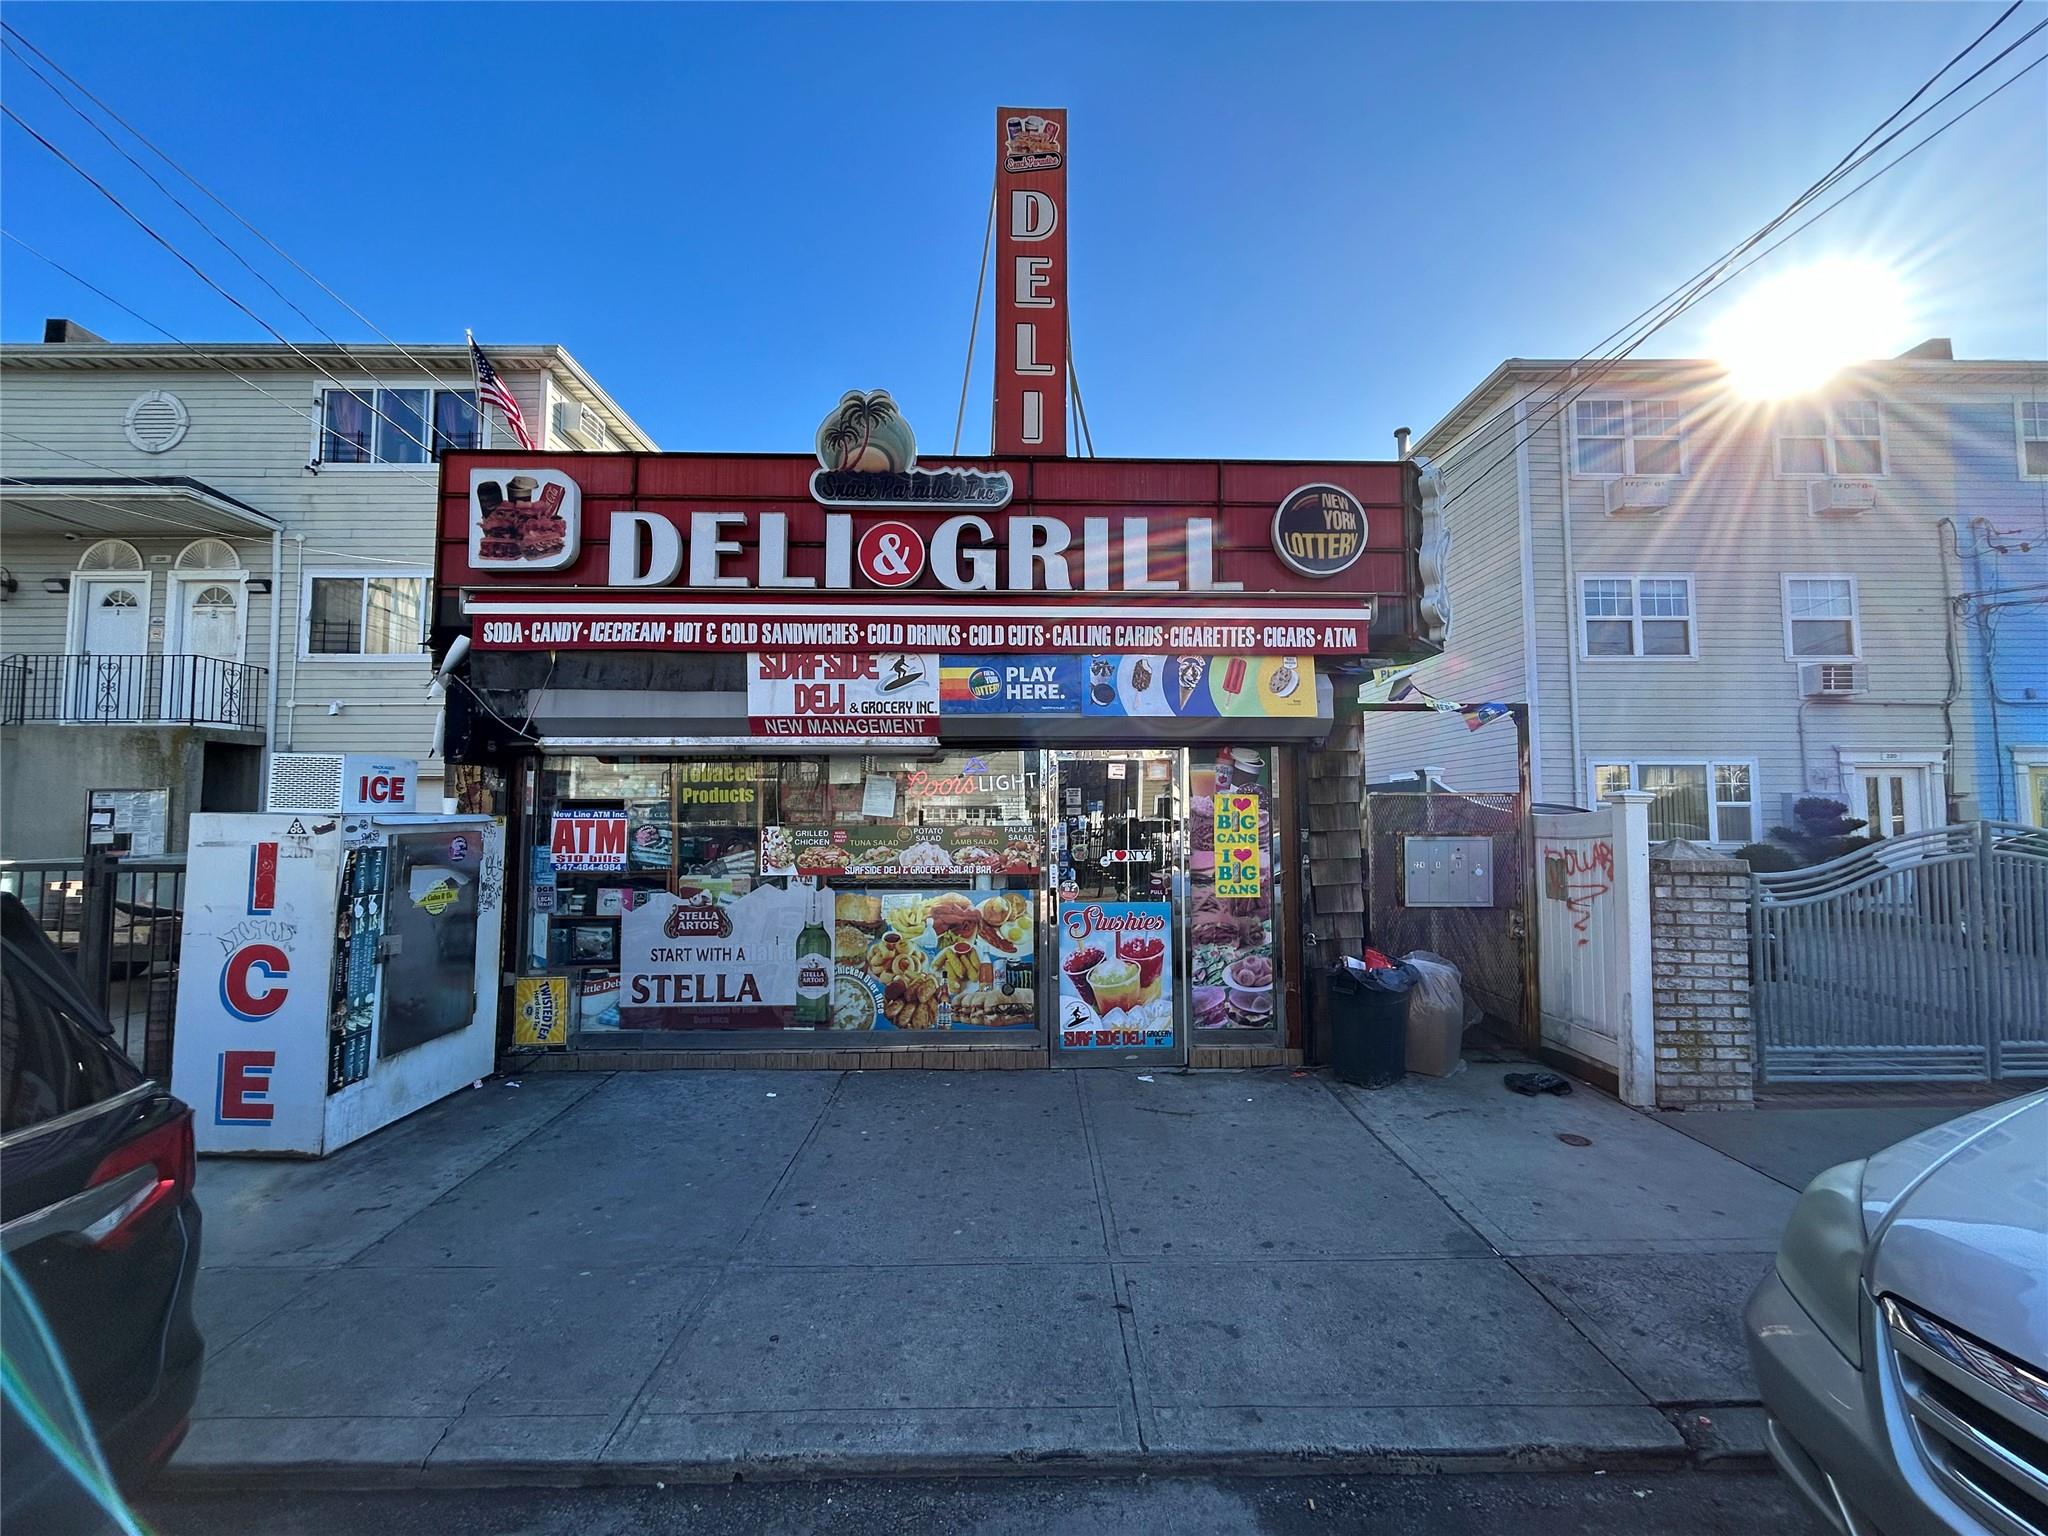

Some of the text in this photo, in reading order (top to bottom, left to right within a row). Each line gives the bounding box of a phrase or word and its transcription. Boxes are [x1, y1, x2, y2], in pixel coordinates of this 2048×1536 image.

[1010, 190, 1058, 445] DELI
[822, 474, 1000, 501] Snack Paradise Inc.
[1321, 493, 1349, 510] NEW
[1323, 510, 1357, 530] YORK
[608, 511, 1244, 591] DELI & GRILL
[1284, 531, 1359, 560] LOTTERY
[483, 621, 1357, 648] SODA CANDY ICECREAM HOT & COLD SANDWICHES COLD DRINKS COLD CUTS CALLING CARDS CIGARETTES CIGARS ATM
[1006, 666, 1057, 682] PLAY
[794, 683, 938, 715] DELI & GROCERY INC.
[1006, 683, 1066, 700] HERE.
[764, 718, 926, 735] NEW MANAGEMENT
[359, 775, 406, 804] ICE
[907, 769, 978, 798] Coors
[978, 772, 1037, 792] LIGHT
[682, 787, 755, 804] Products
[1222, 797, 1230, 812] I
[553, 810, 572, 818] New
[573, 810, 591, 818] Line
[551, 820, 625, 853] ATM
[913, 827, 944, 835] POTATO
[1216, 832, 1257, 844] CANS
[794, 838, 830, 846] CHICKEN
[850, 839, 872, 847] TUNA
[973, 838, 999, 846] SALAD
[556, 854, 621, 863] $10 bills
[1109, 850, 1114, 861] I
[1222, 849, 1231, 863] I
[555, 863, 622, 871] 347-484-4984
[844, 865, 881, 875] SURFSIDE
[884, 865, 901, 874] DELI
[910, 865, 945, 875] GROCERY
[948, 865, 975, 874] SALAD
[976, 865, 992, 874] BAR
[1218, 884, 1259, 895] CANS
[678, 911, 719, 920] STELLA
[1063, 904, 1165, 939] Slushies
[677, 921, 720, 930] ARTOIS
[650, 948, 692, 962] START
[696, 947, 732, 962] WITH
[735, 947, 746, 961] A
[631, 973, 763, 1004] STELLA
[537, 981, 553, 1040] TWISTED TEA
[1064, 1030, 1173, 1047] SURF SIDE DELI GROCERY
